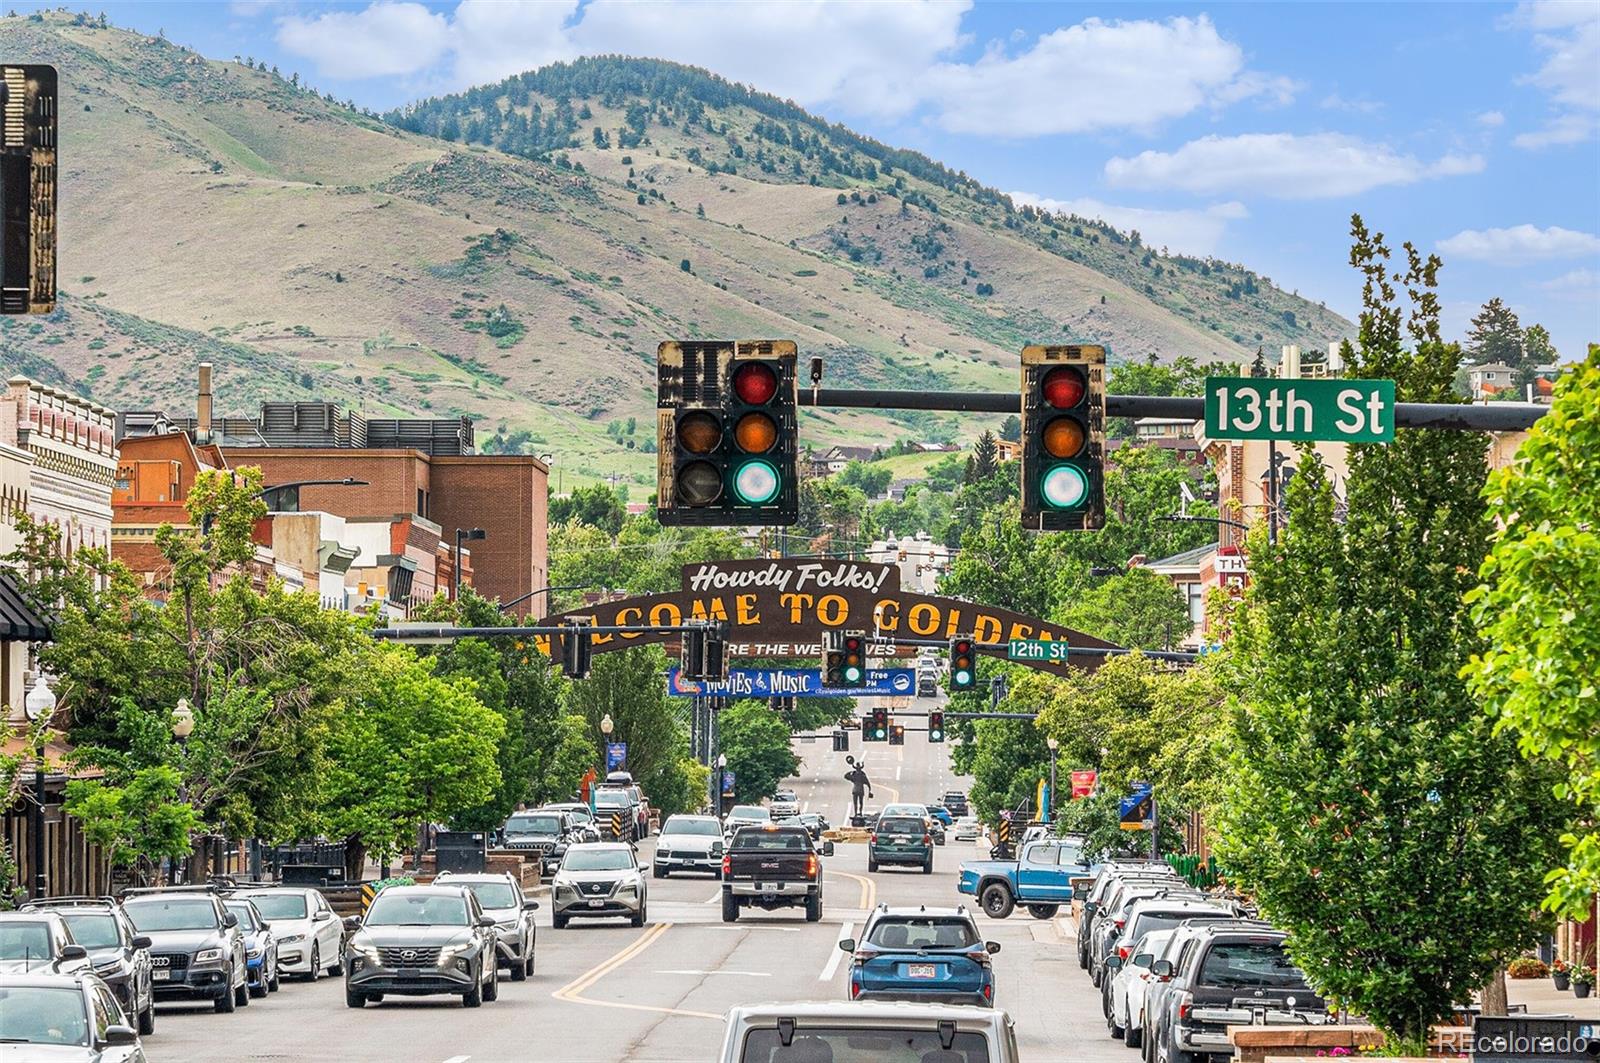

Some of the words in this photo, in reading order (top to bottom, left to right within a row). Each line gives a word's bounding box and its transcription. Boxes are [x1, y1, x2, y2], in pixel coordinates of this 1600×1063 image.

[1215, 387, 1313, 433] 13th
[1335, 388, 1385, 435] St
[690, 562, 793, 592] Howdy
[795, 563, 890, 594] Folks!
[780, 592, 850, 627] TO
[754, 643, 789, 656] THE
[1011, 641, 1044, 658] 12th
[1050, 642, 1066, 659] St
[870, 671, 889, 680] Free
